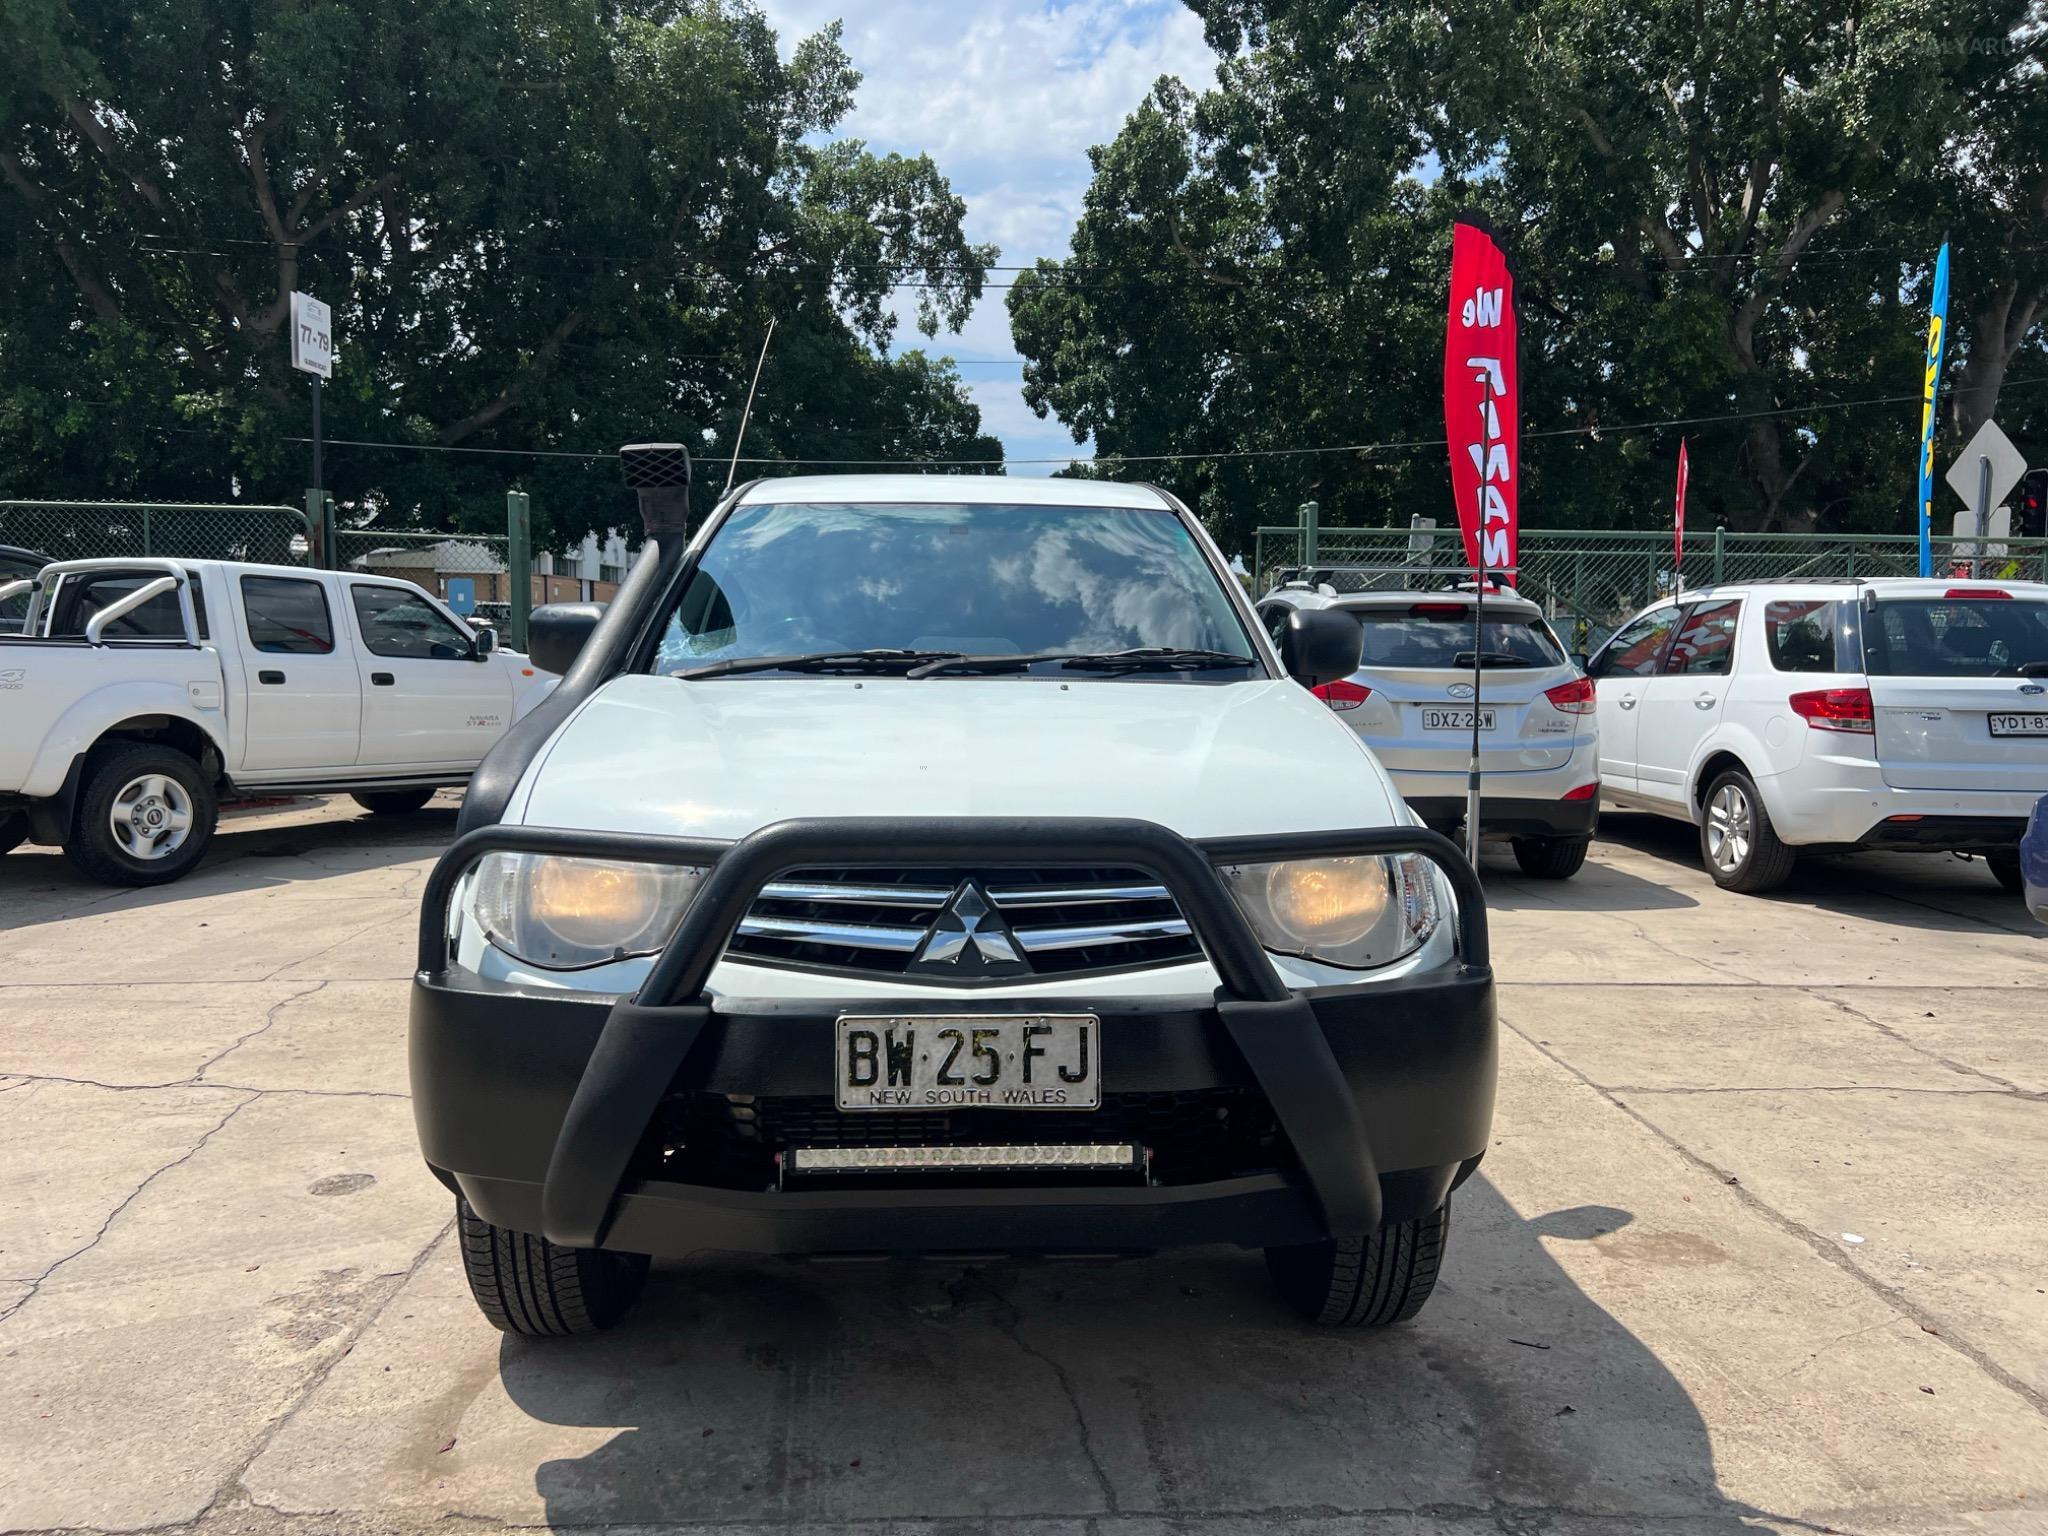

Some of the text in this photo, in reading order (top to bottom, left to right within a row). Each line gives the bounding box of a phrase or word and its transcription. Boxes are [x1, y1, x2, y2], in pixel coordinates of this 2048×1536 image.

[869, 1089, 1067, 1105] NEW SOUTH WALES
